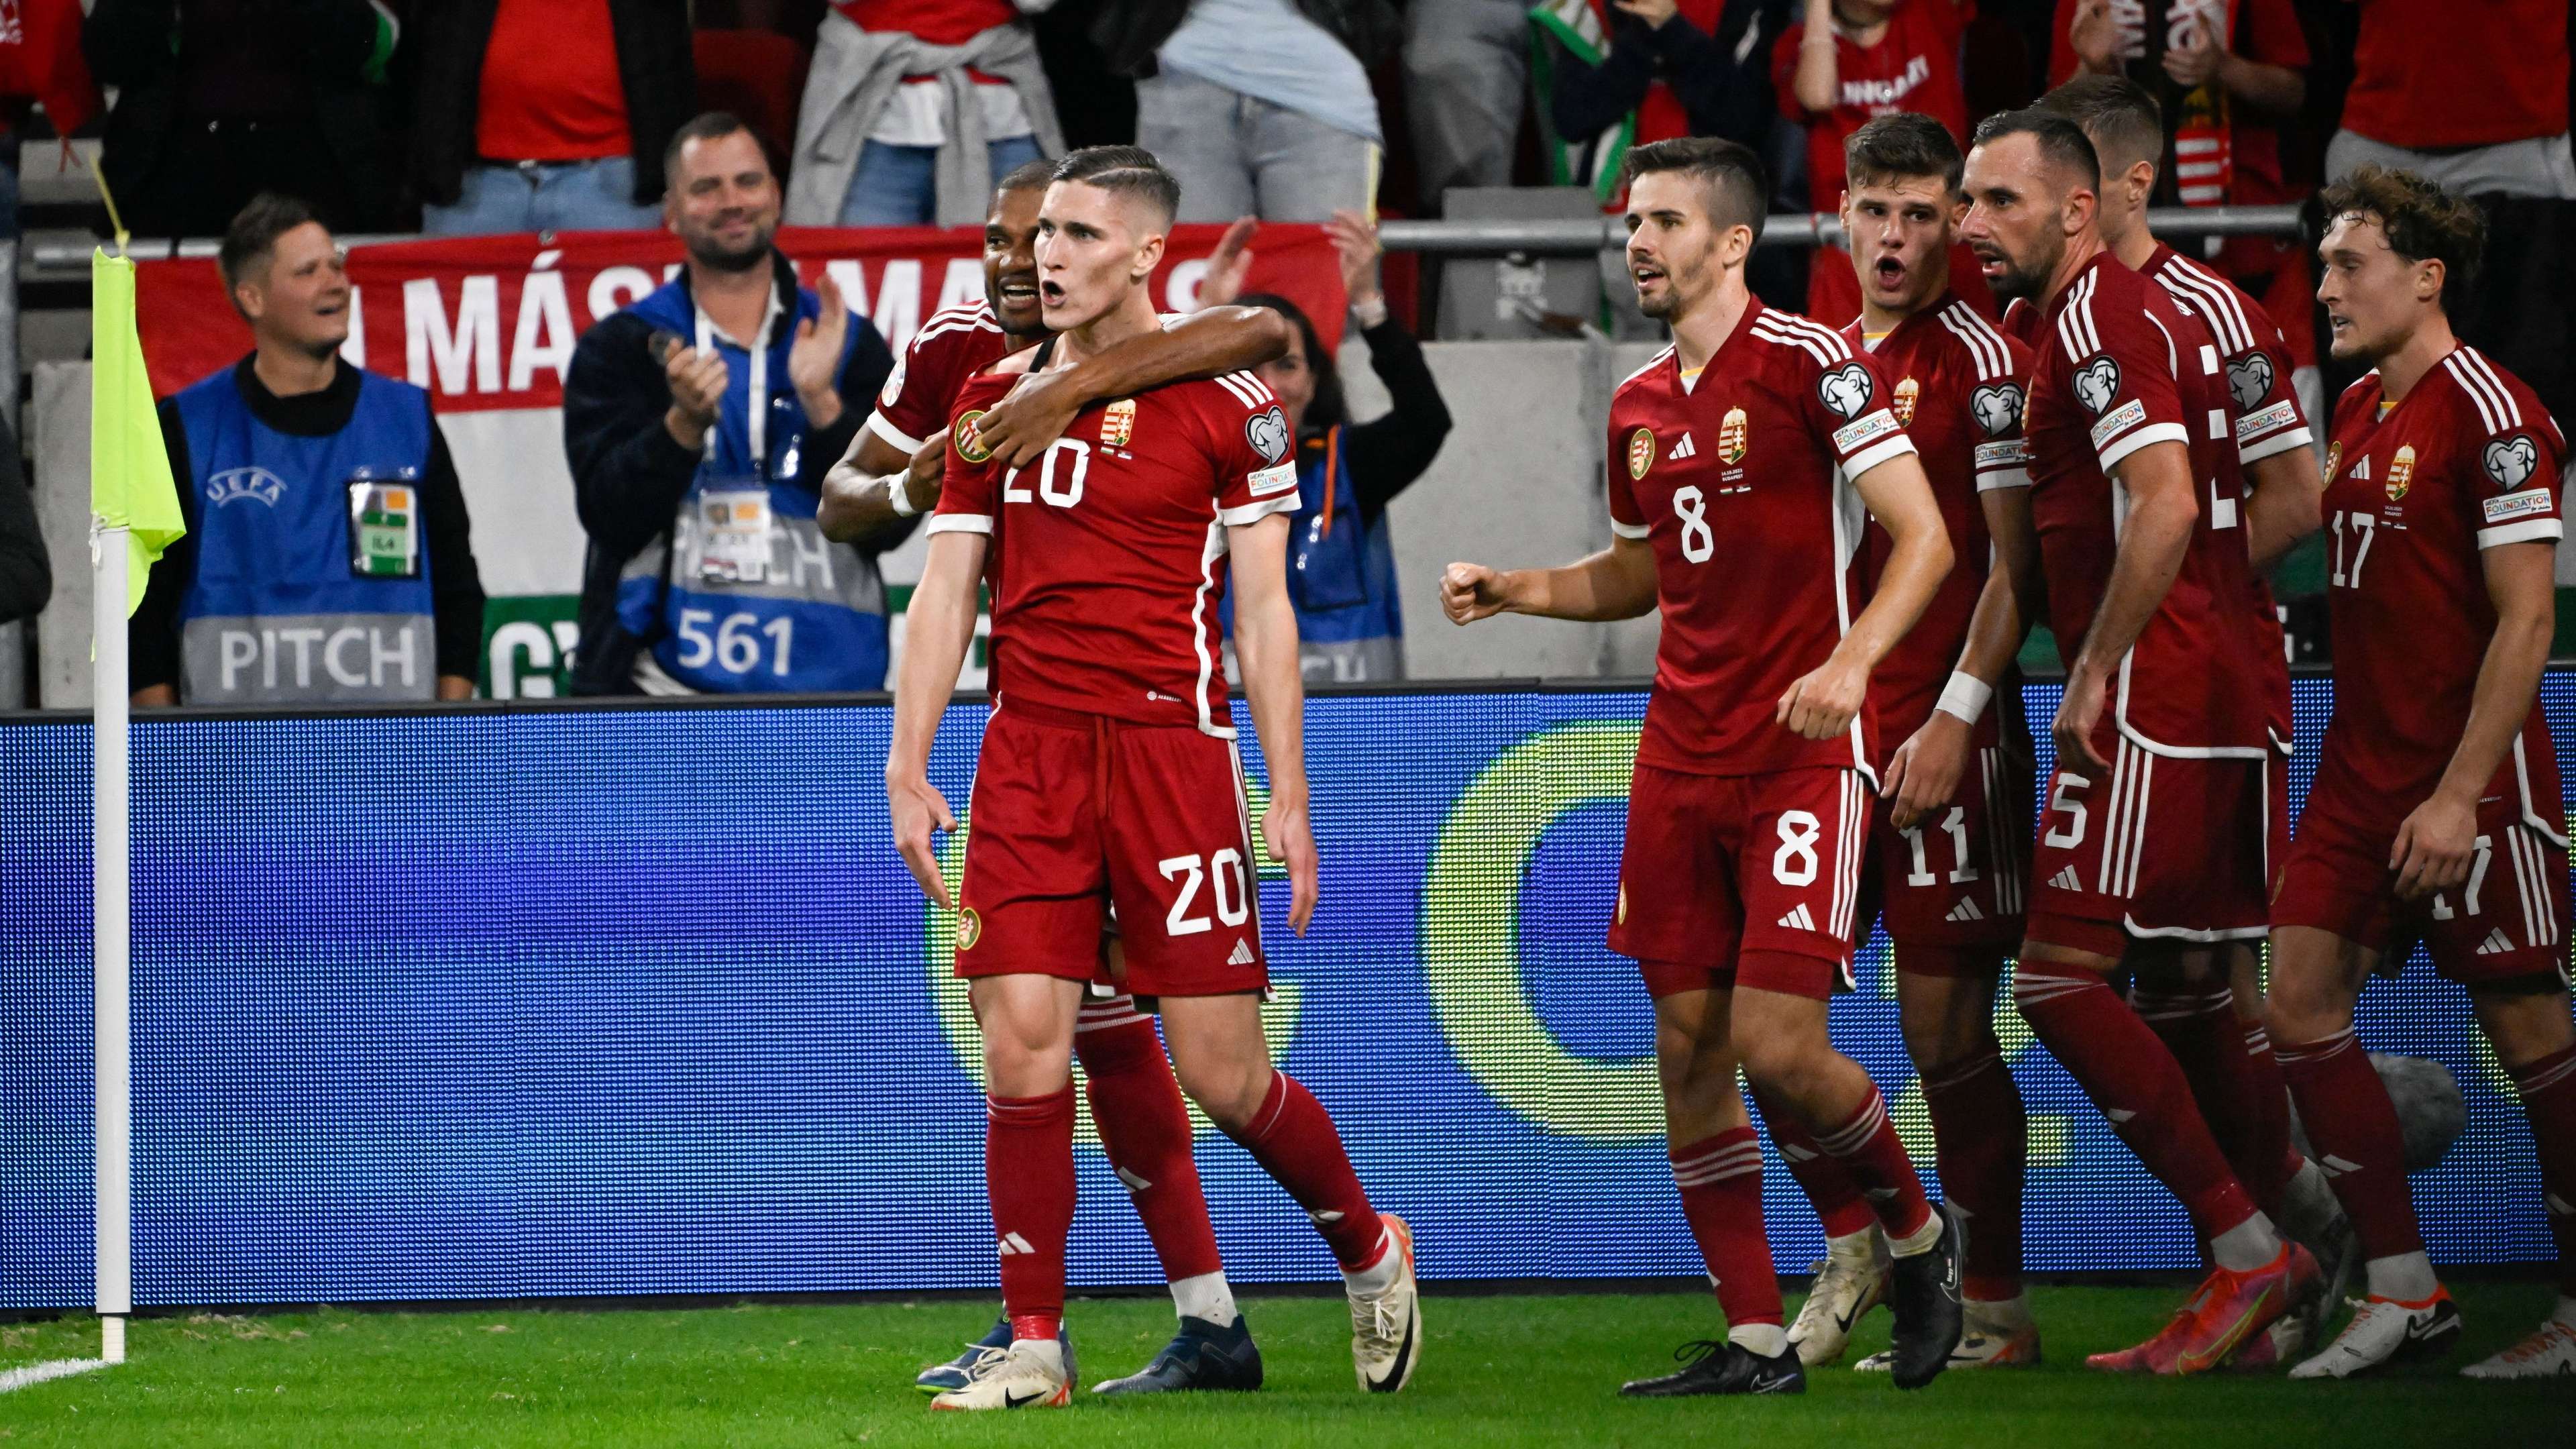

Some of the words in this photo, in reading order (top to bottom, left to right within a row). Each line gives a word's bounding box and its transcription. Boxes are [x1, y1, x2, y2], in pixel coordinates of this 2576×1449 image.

[1837, 415, 1892, 446] FOUNDATIO
[1976, 444, 2022, 461] FOUNDATI
[2093, 405, 2143, 443] FOUNDATION
[2237, 407, 2294, 434] OUNDATION
[205, 467, 287, 508] UEFA
[2486, 494, 2550, 515] FOUNDATION
[1672, 485, 1714, 564] 8
[2332, 510, 2375, 588] 17
[221, 626, 417, 690] PITCH
[678, 608, 794, 676] 561
[2044, 772, 2091, 849] 5
[1772, 810, 1820, 886] 8
[1900, 806, 1978, 887] 11
[1159, 847, 1248, 936] 20
